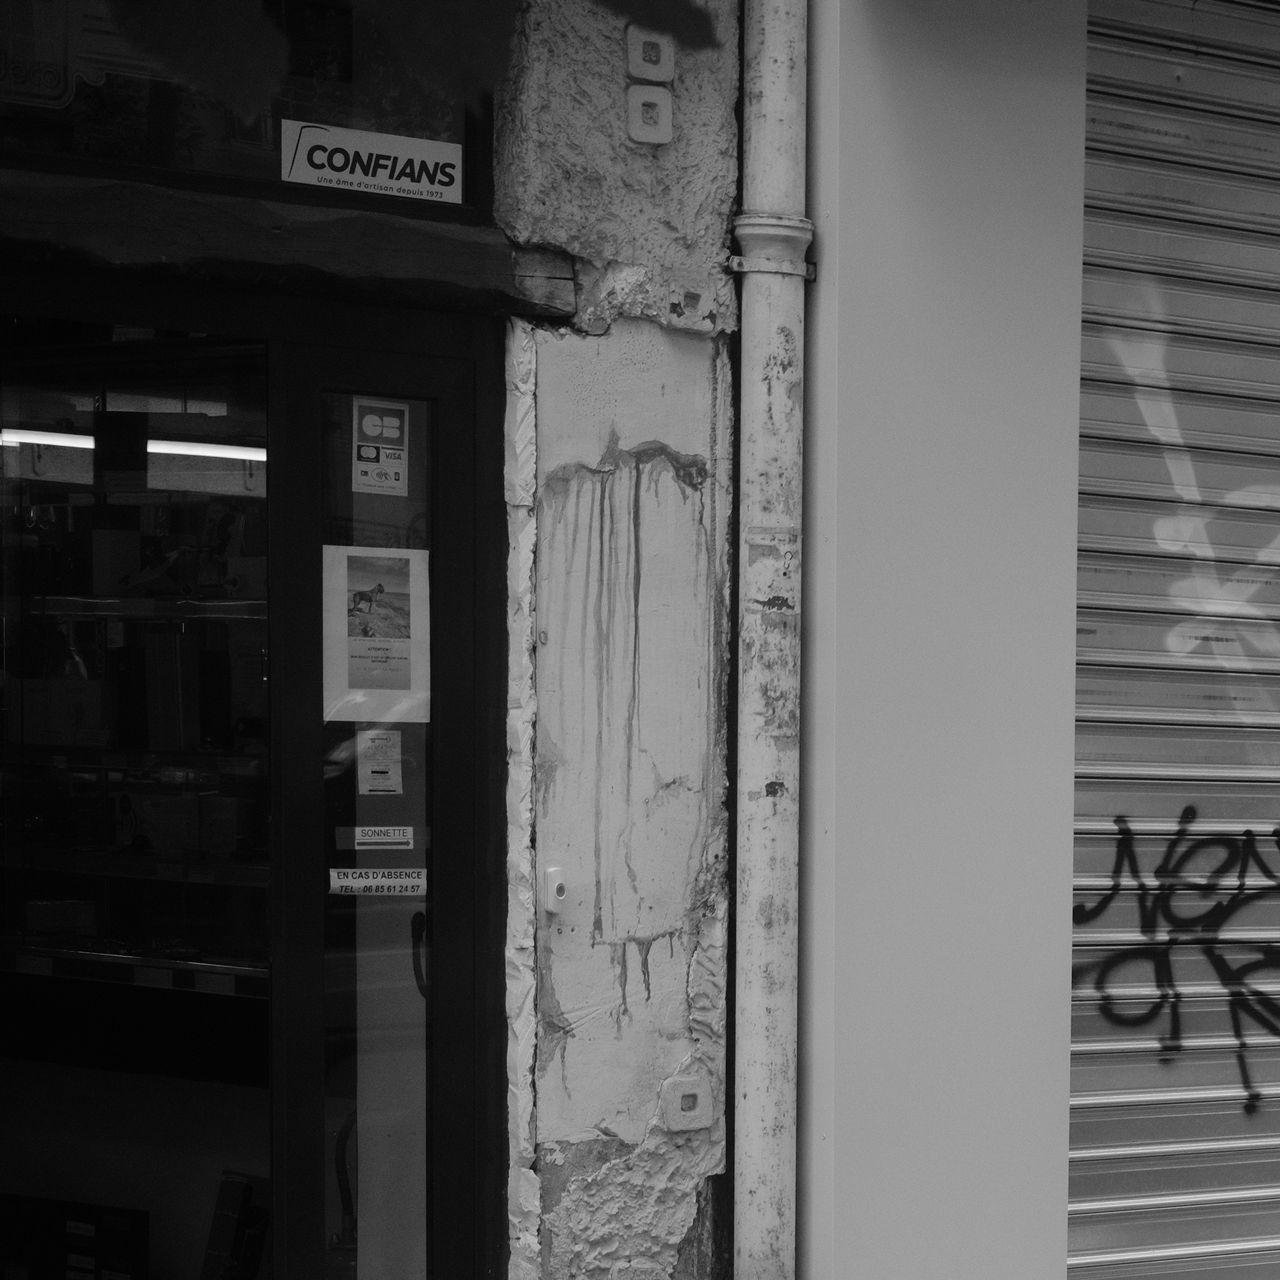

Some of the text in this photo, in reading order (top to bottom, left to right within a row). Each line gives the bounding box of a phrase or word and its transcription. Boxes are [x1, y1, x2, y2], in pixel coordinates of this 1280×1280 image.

[307, 144, 456, 187] CONFIANS
[317, 176, 333, 184] Une
[357, 181, 394, 193] d'artisan
[396, 185, 424, 197] depuis
[426, 189, 443, 199] 1973
[361, 828, 408, 838] SONNETTE
[337, 871, 423, 880] EN CAS D'ABSENCE
[340, 885, 354, 893] TEL
